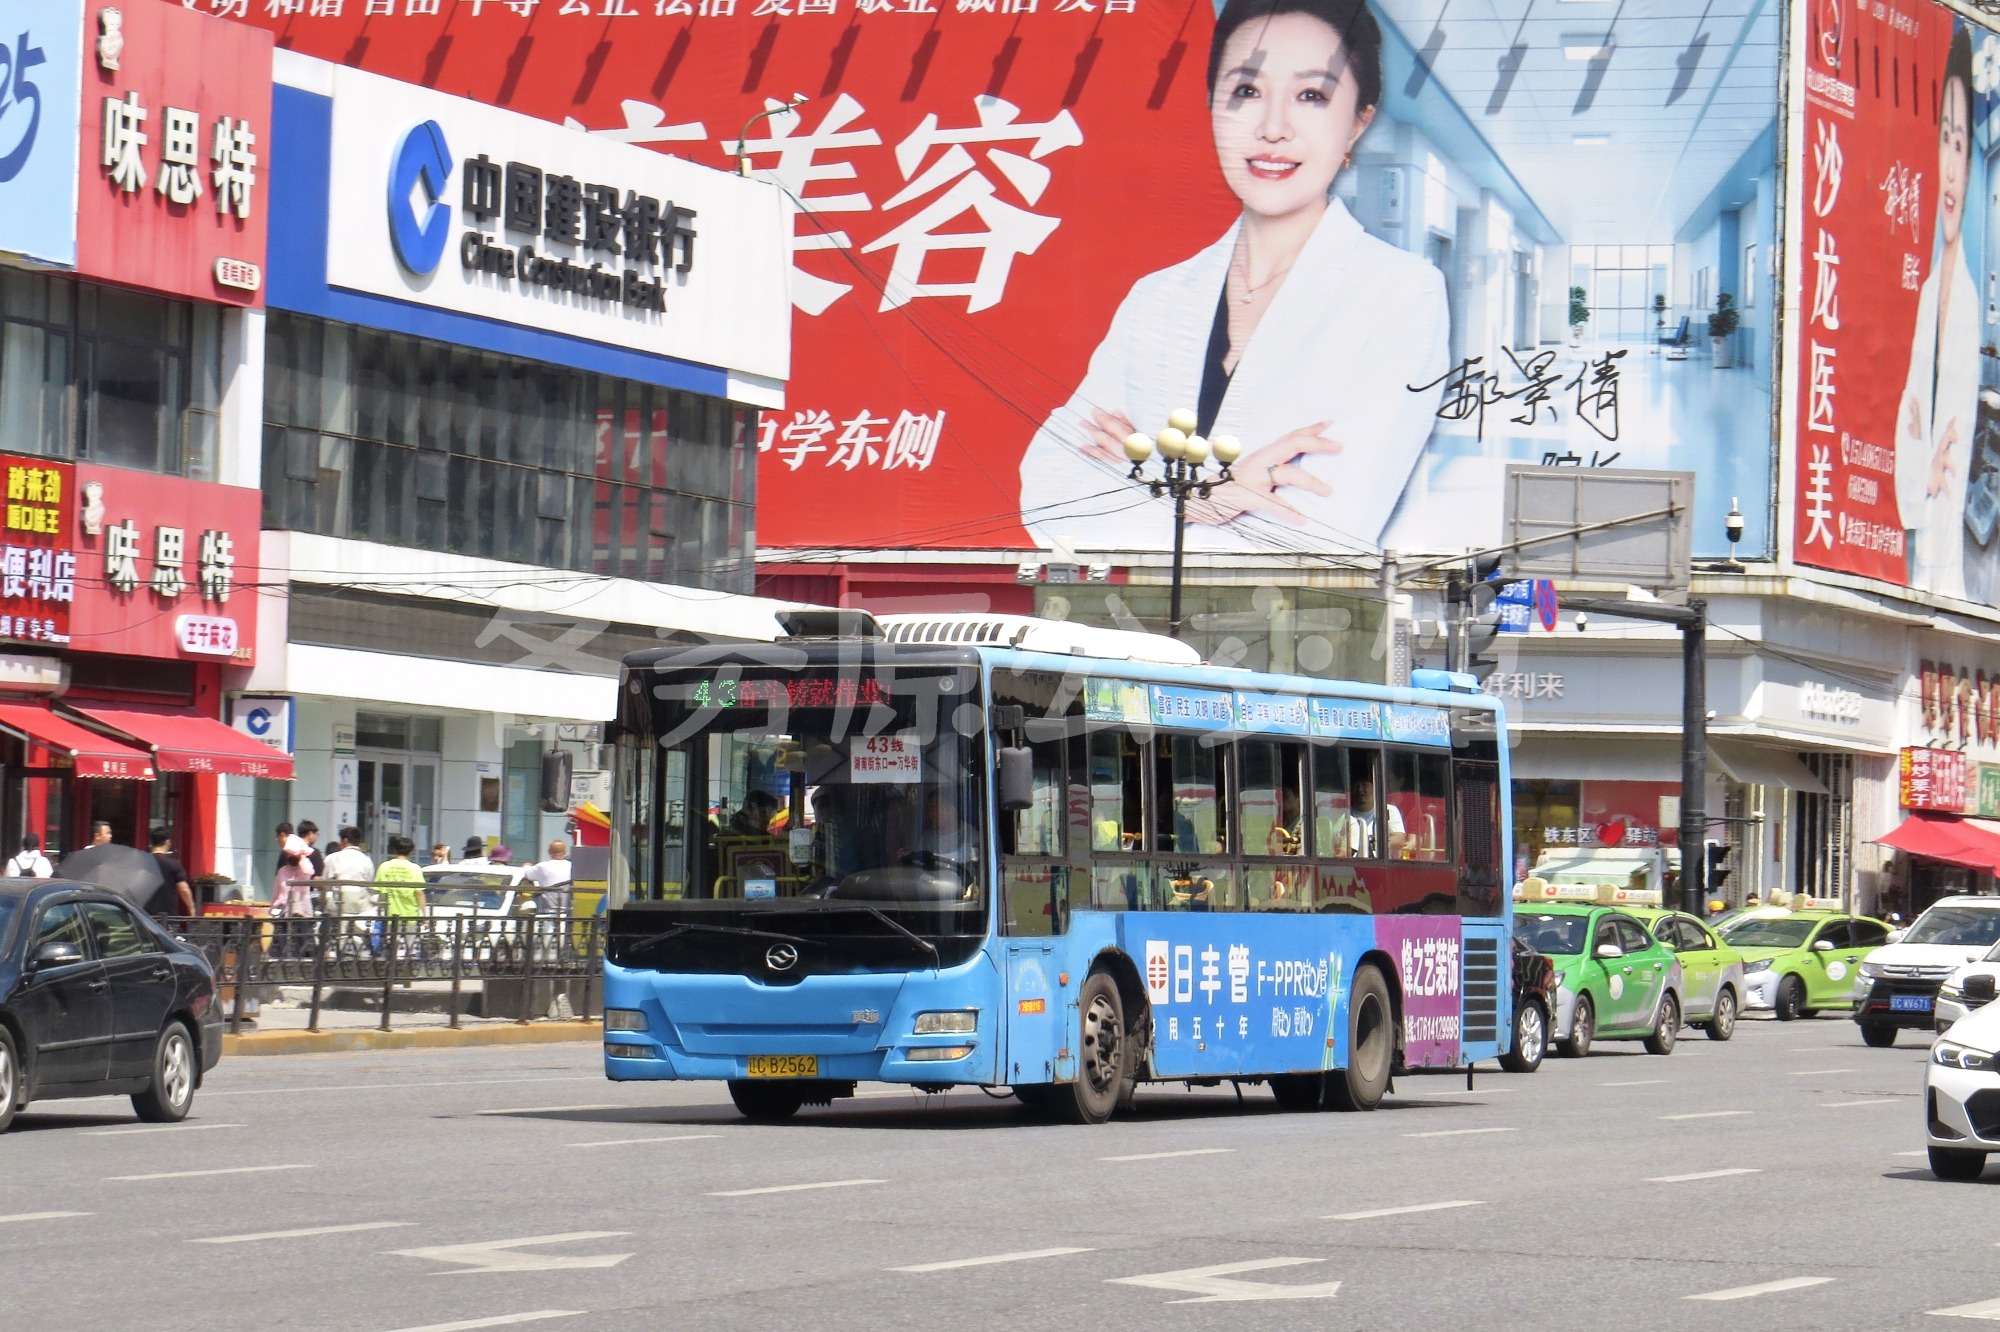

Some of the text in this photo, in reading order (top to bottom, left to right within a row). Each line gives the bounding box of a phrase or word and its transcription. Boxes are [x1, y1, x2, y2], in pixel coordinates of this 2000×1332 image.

[100, 90, 258, 219] 味思特
[462, 153, 697, 273] 中国建设银行
[563, 93, 1085, 316] 美容
[461, 231, 668, 314] China Construction Bank
[1803, 118, 1845, 550] 沙龙医美
[3, 546, 76, 603] 便利店
[104, 519, 234, 603] 味思特
[187, 621, 232, 650] 王子麻花
[694, 679, 737, 708] 43
[1481, 672, 1565, 700] 好利来
[1176, 696, 1191, 718] 民主
[1194, 699, 1210, 720] 文明
[866, 737, 905, 754] 43线
[897, 756, 919, 771] 万华街
[1543, 826, 1593, 844] 铁东区
[1174, 943, 1250, 1005] 日丰管
[1152, 1014, 1249, 1041] 用五十年
